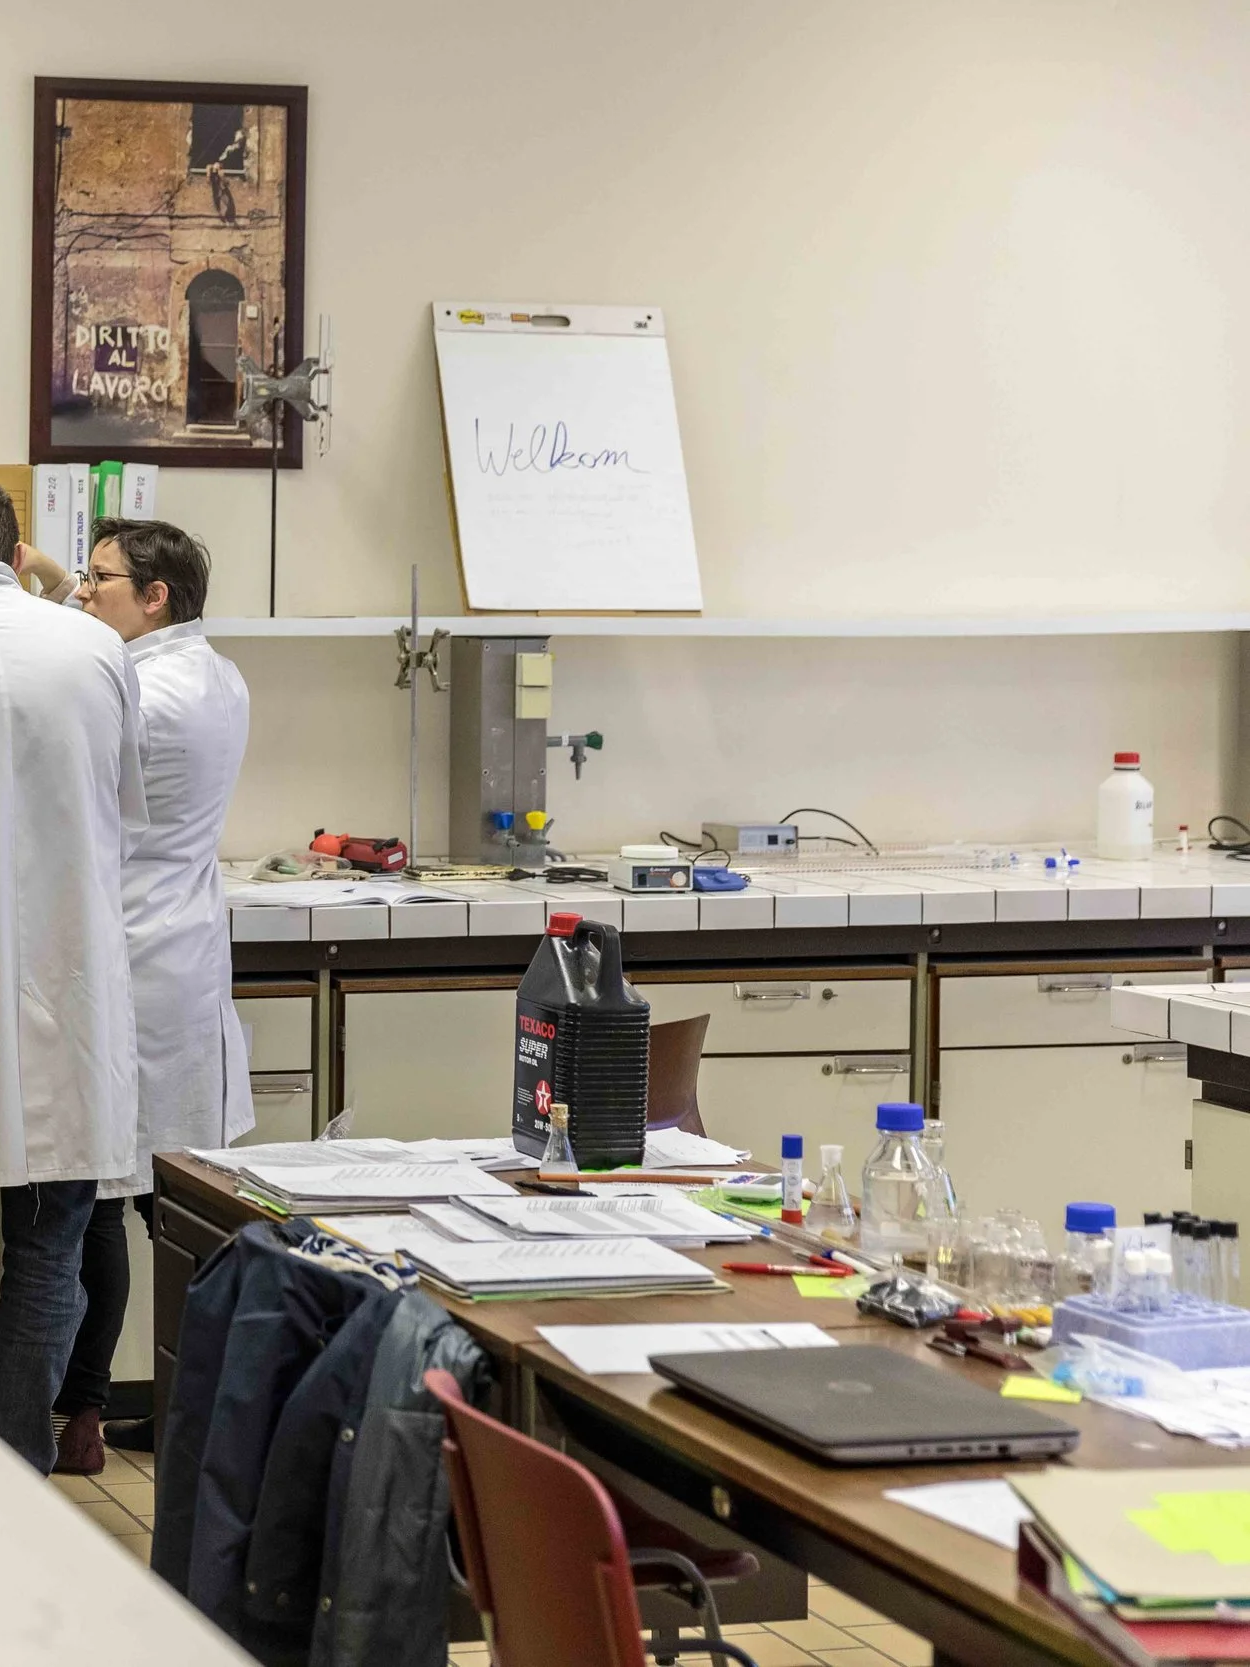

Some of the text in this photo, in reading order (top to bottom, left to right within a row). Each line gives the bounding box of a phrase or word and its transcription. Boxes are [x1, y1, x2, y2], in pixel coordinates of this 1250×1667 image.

[75, 324, 170, 354] DIRITTO
[108, 349, 135, 367] AL
[72, 369, 168, 405] LAVORO
[48, 476, 57, 490] 2/2
[137, 476, 146, 486] 1/2
[519, 1015, 555, 1040] TEXACO
[519, 1036, 548, 1059] SUPER
[519, 1054, 539, 1067] MOTOR OIL
